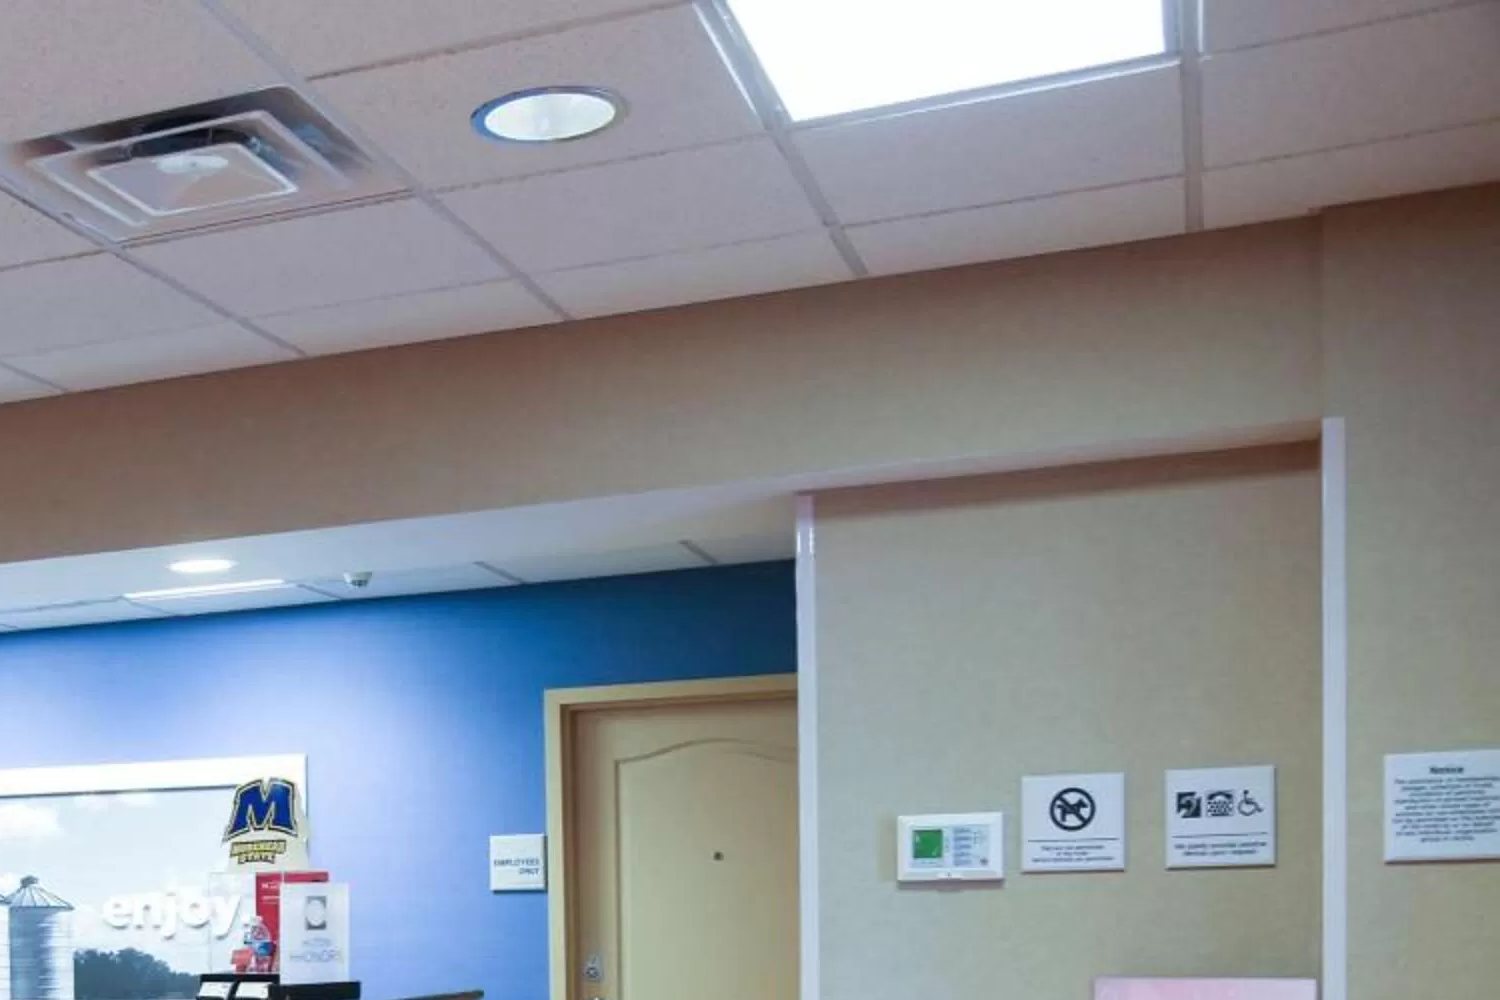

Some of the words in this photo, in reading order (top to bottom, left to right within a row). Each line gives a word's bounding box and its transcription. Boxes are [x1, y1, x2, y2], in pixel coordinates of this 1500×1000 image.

[222, 777, 298, 842] M
[493, 857, 540, 866] EMPLOYEES
[101, 885, 242, 941] enjoy
